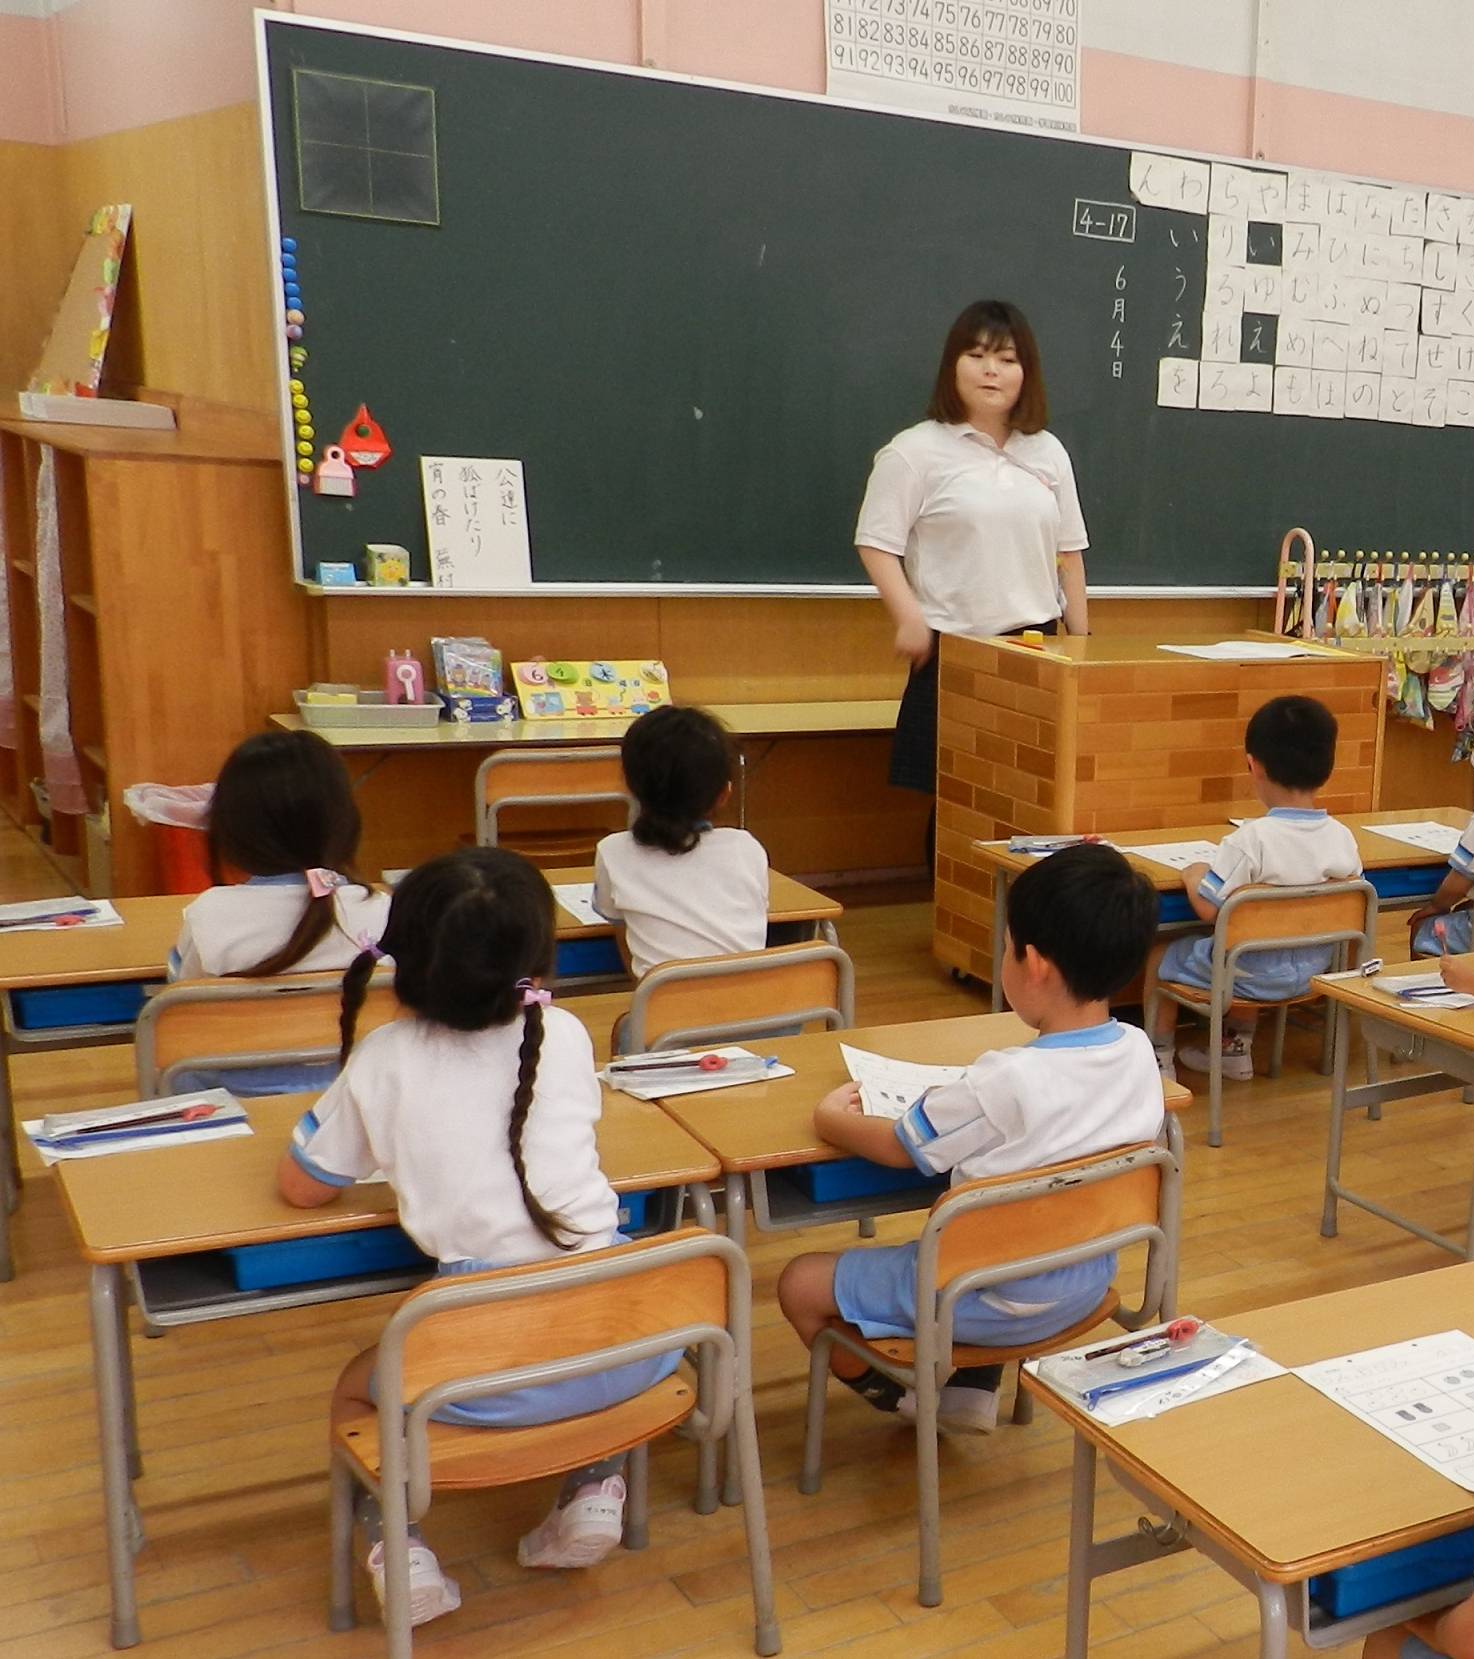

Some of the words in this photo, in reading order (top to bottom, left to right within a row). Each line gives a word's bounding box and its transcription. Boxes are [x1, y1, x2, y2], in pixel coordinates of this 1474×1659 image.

[834, 13, 851, 36] 81
[859, 18, 879, 41] 82
[884, 23, 904, 45] 83
[909, 27, 928, 49] 84
[934, 32, 955, 53] 85
[959, 36, 979, 58] 86
[984, 41, 1004, 61] 87
[1008, 45, 1027, 66] 88
[1031, 49, 1050, 70] 89
[1055, 53, 1073, 74] 90
[935, 1, 955, 24] 75
[960, 6, 980, 28] 76
[985, 10, 1005, 32] 77
[1009, 15, 1028, 37] 78
[1033, 20, 1051, 40] 79
[1056, 24, 1074, 45] 80
[835, 45, 853, 65] 91
[859, 49, 880, 70] 92
[884, 53, 904, 75] 93
[909, 58, 928, 79] 94
[934, 62, 954, 83] 95
[958, 66, 978, 87] 96
[983, 70, 1003, 91] 97
[1006, 74, 1025, 95] 98
[1030, 78, 1049, 98] 99
[1054, 82, 1073, 102] 100
[1079, 207, 1128, 238] 4-17
[1110, 265, 1127, 379] 6月4日
